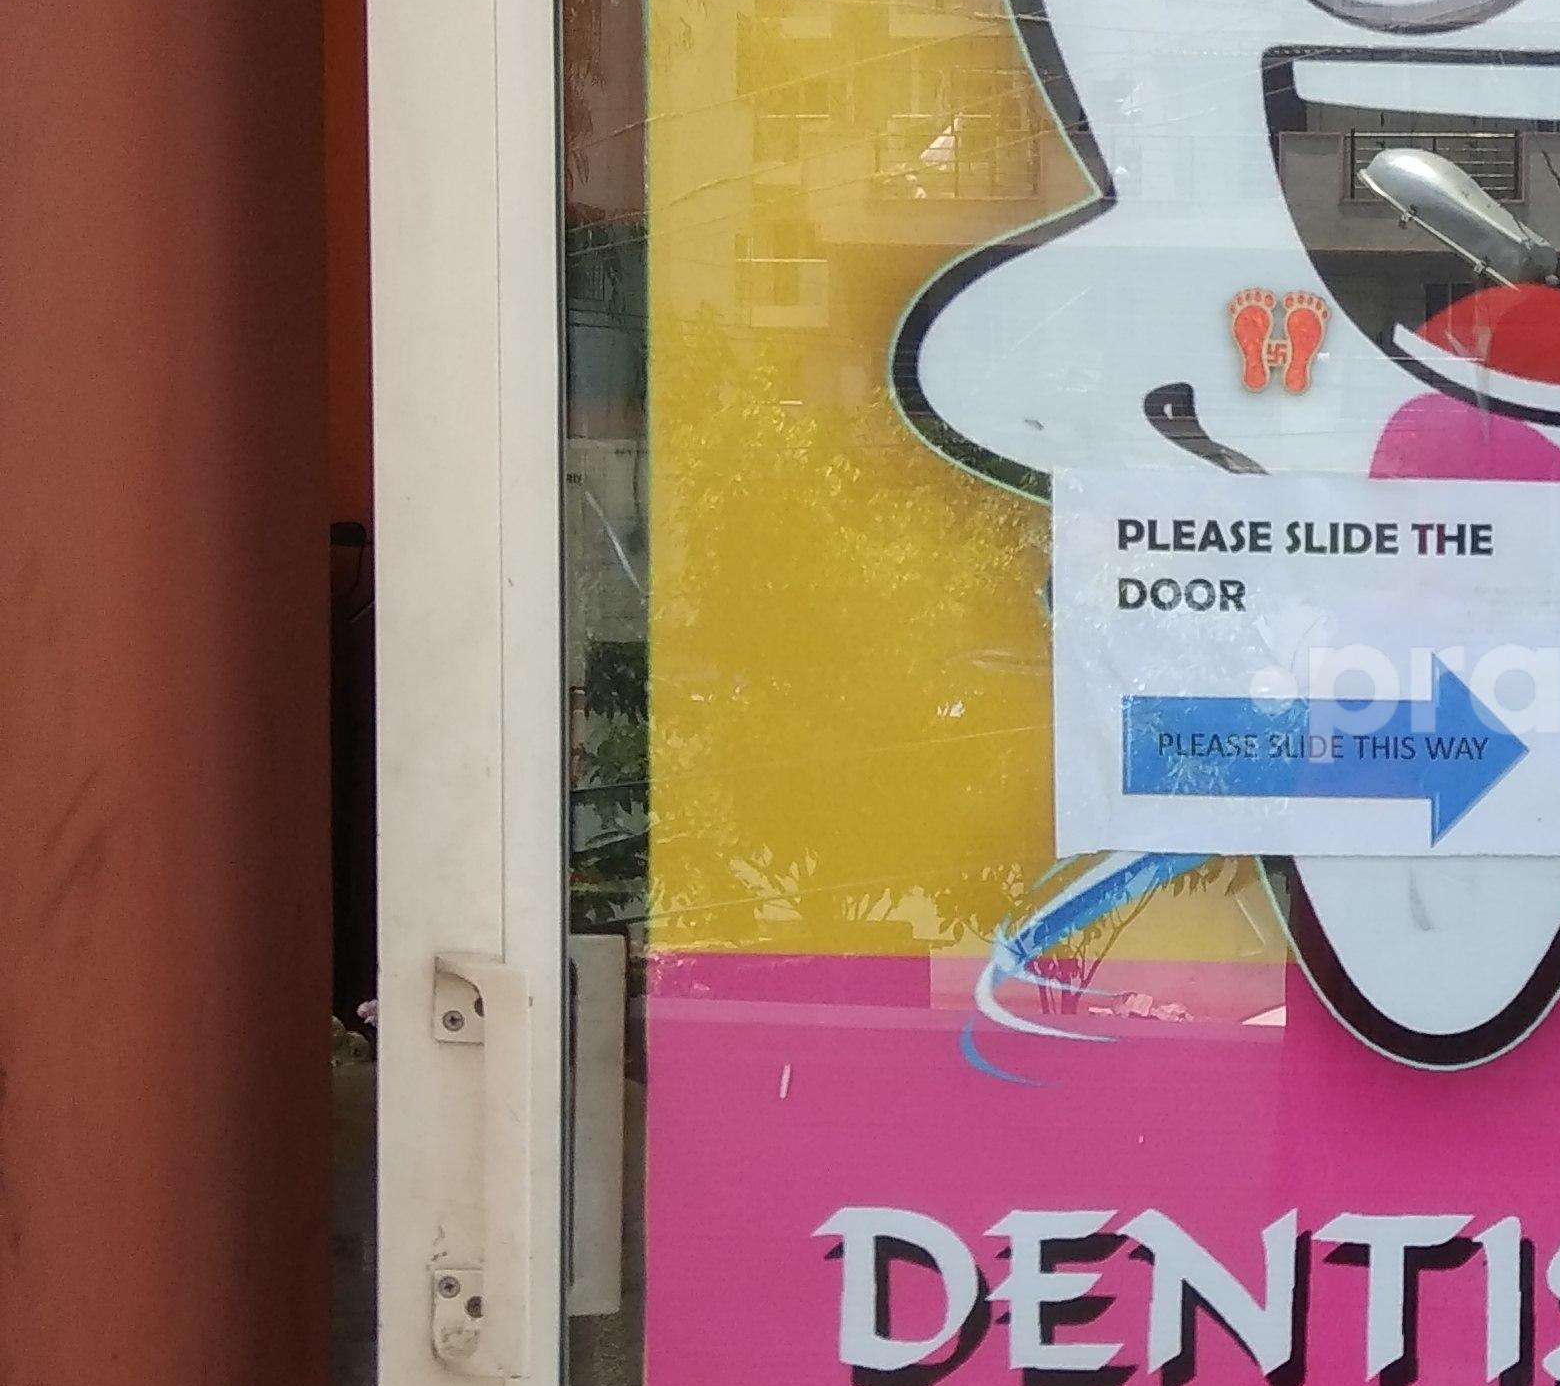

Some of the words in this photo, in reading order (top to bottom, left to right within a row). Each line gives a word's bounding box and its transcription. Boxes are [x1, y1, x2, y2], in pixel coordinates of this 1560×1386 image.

[1116, 519, 1272, 555] PLEASE
[1284, 520, 1399, 557] SLIDE
[1411, 522, 1495, 558] THE
[1116, 577, 1247, 612] DOOR
[1157, 732, 1258, 759] PLEASE
[1268, 733, 1345, 760] SLIDE
[1354, 734, 1417, 761] THIS
[1423, 735, 1490, 762] WAY
